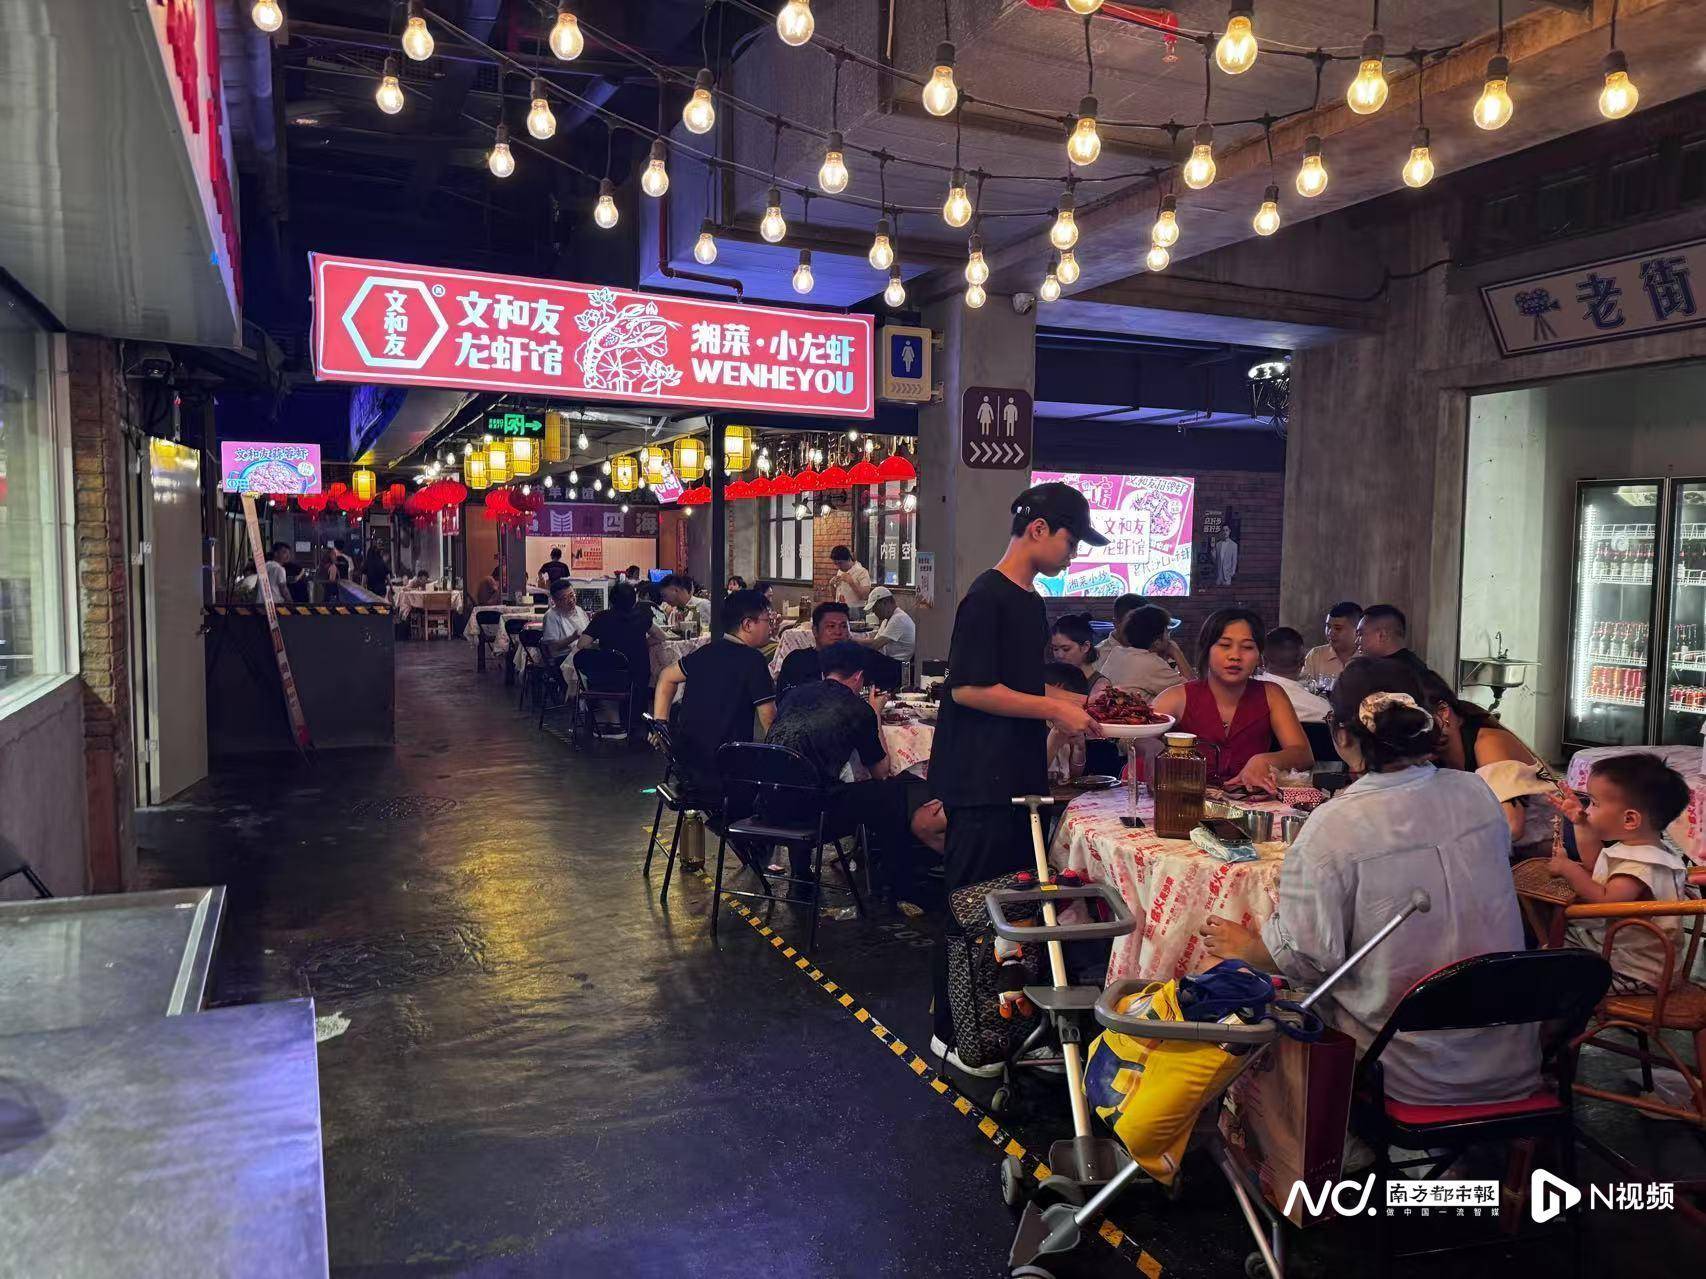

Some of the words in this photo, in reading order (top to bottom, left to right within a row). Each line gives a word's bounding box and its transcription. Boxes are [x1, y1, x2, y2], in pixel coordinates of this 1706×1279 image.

[455, 291, 565, 336] 文和友
[1575, 254, 1697, 330] 老街
[383, 290, 409, 357] 文和友
[690, 320, 855, 367] 湘菜·小龙虾
[454, 331, 563, 376] 龙虾馆
[692, 358, 855, 395] WENHEYOU
[1103, 538, 1146, 556] 龙虾馆
[1104, 517, 1146, 536] 文和友
